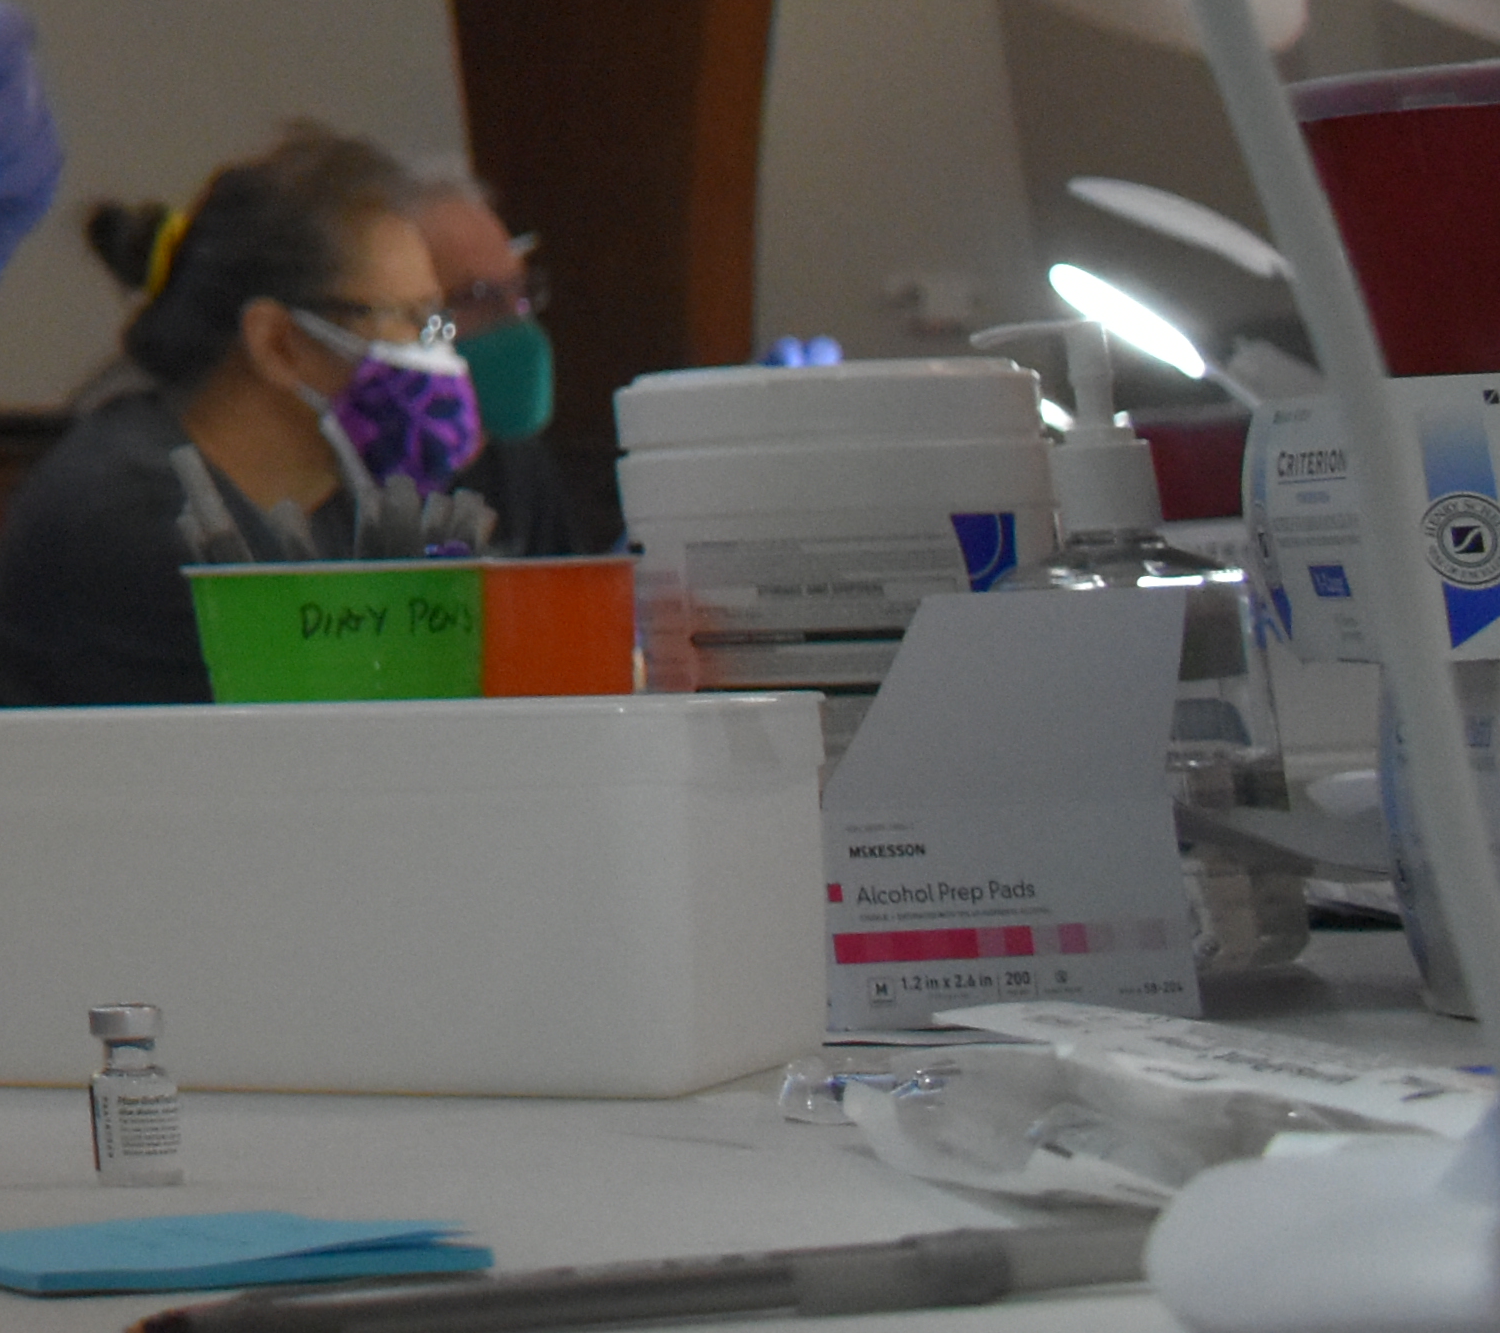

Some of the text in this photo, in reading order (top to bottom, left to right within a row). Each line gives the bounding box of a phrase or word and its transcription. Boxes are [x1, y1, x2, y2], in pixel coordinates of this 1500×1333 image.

[1277, 449, 1348, 477] CRITERION
[857, 879, 1035, 905] Alcohol Prep Pads
[901, 977, 922, 990] 1.2
[925, 976, 939, 990] in
[980, 973, 994, 988] in
[1005, 971, 1031, 986] 200
